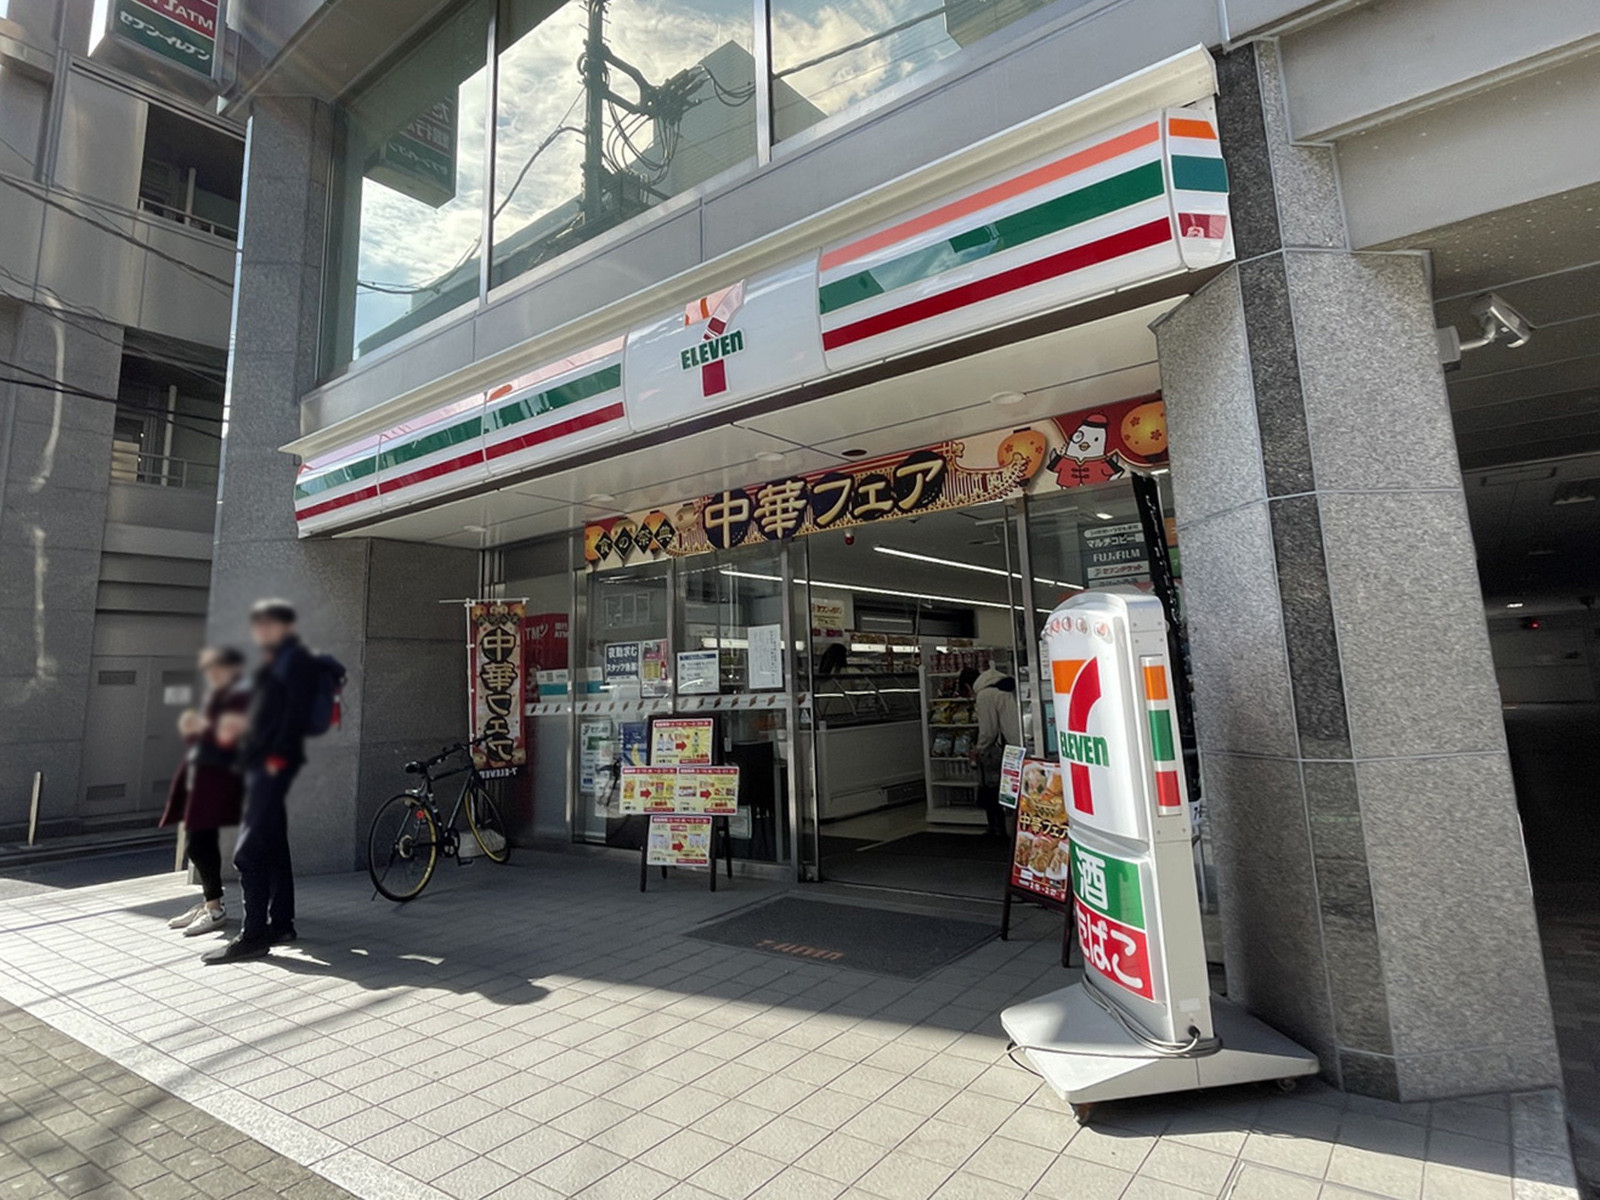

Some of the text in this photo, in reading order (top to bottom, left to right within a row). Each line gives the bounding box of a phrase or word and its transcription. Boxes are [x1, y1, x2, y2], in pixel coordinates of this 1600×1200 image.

[704, 457, 944, 549] 中華フェア
[1075, 847, 1109, 911] 酒
